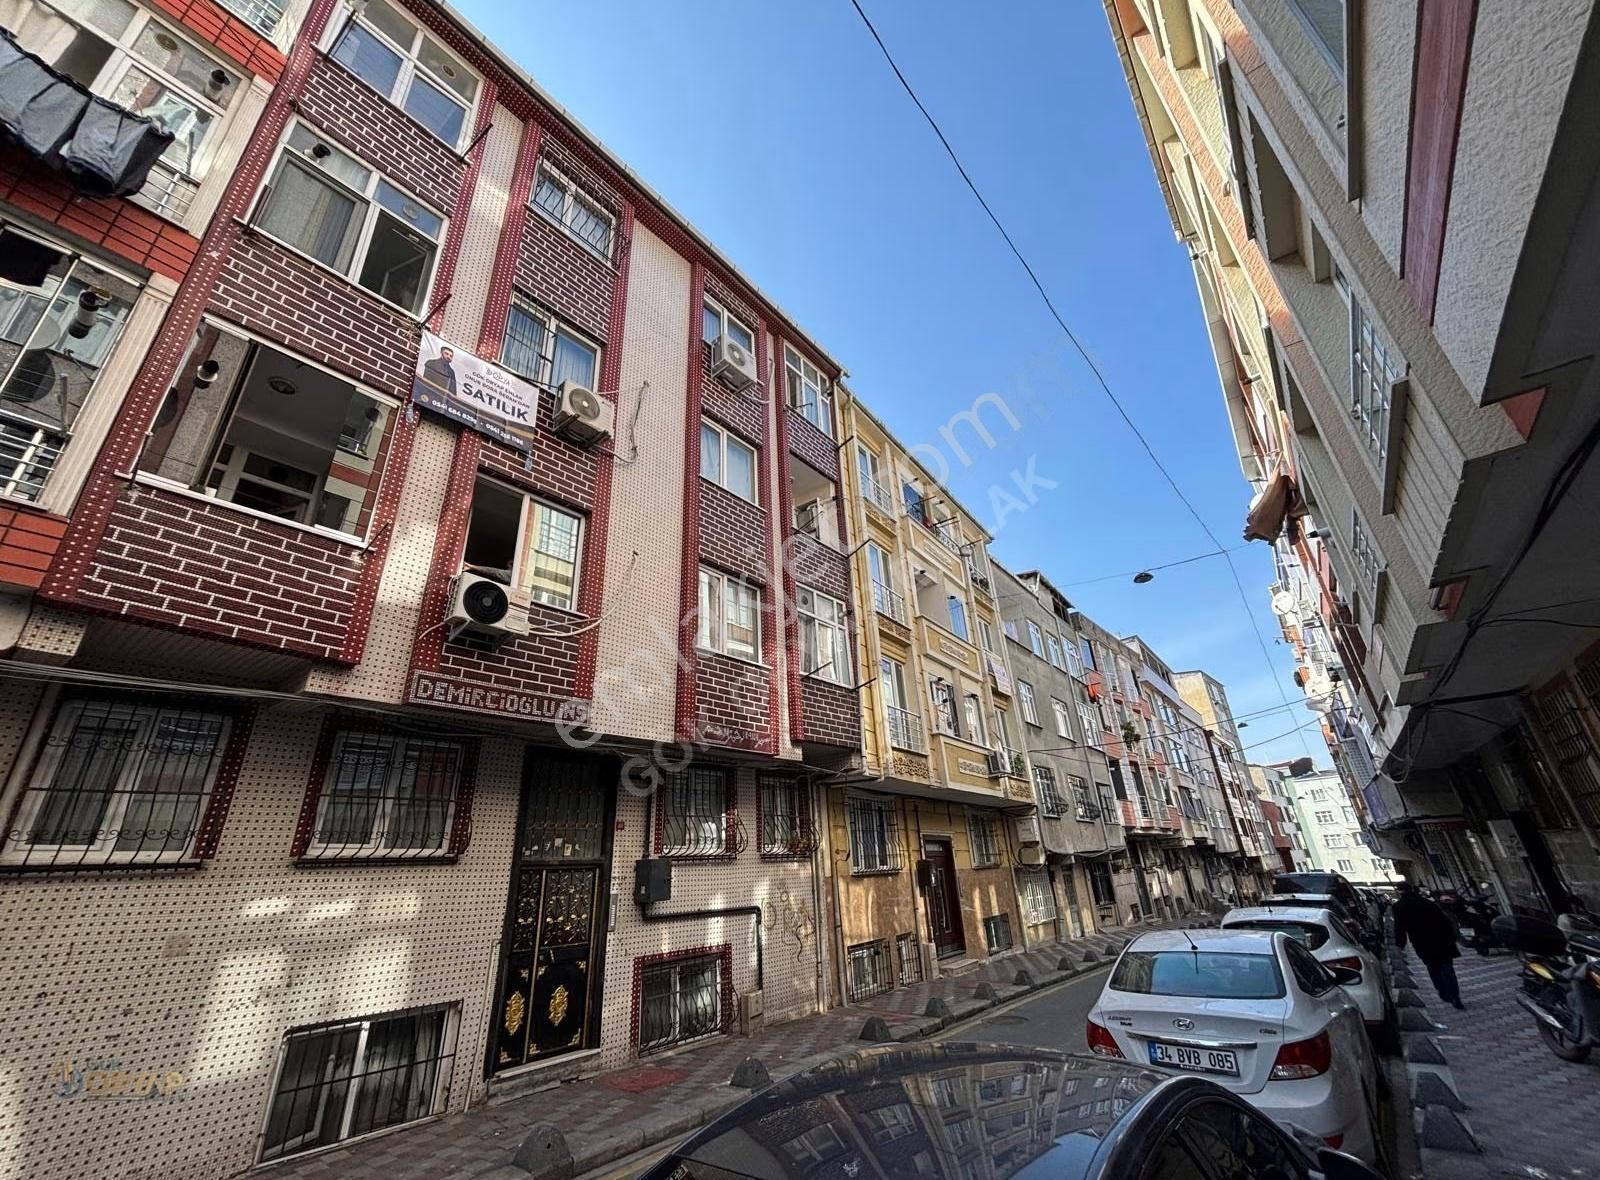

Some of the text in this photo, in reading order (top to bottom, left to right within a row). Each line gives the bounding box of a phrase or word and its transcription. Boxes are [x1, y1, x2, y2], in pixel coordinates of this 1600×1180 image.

[462, 382, 529, 423] SATILIK
[1157, 1045, 1173, 1062] 34
[1176, 1047, 1202, 1066] BVB
[1208, 1051, 1235, 1070] 085
